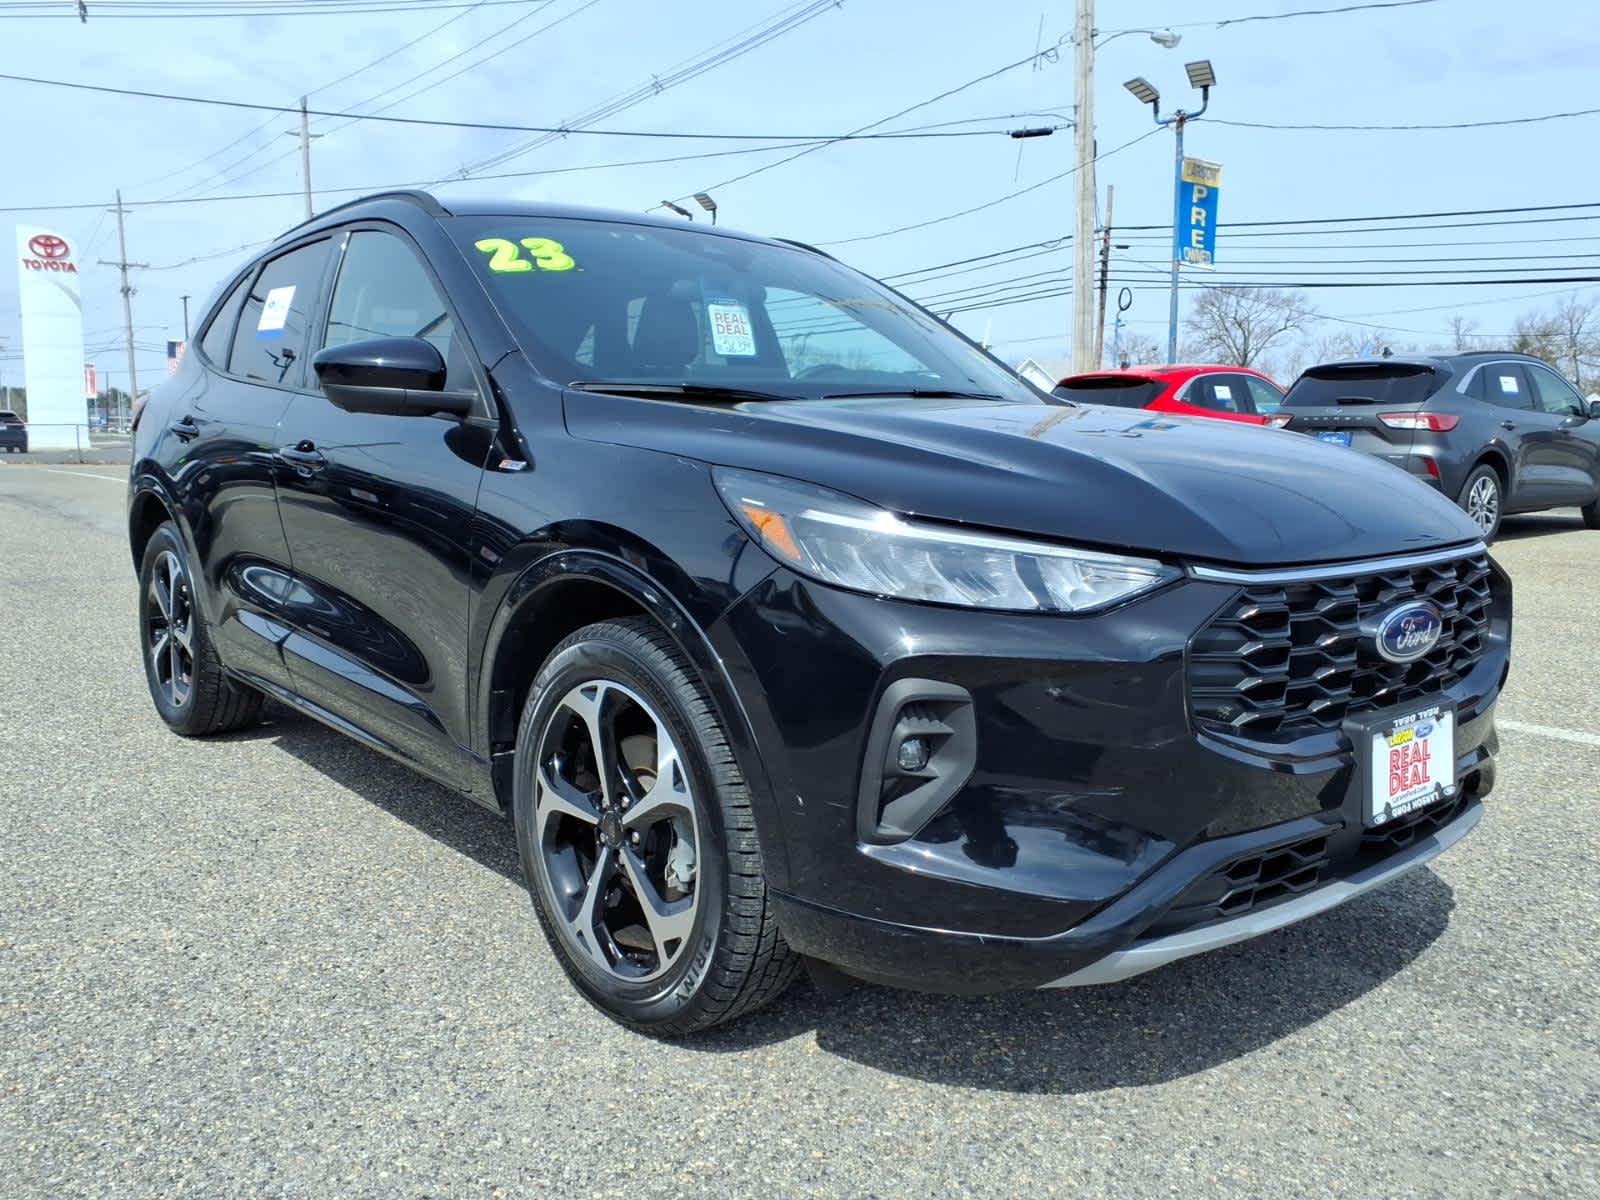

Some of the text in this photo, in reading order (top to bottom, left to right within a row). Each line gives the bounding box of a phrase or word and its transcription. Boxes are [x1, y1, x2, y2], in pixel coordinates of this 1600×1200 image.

[1191, 185, 1208, 248] PRE
[22, 258, 78, 274] TOYOTA
[474, 237, 576, 272] 23
[714, 312, 747, 324] REAL
[716, 324, 749, 336] DEAL
[1396, 616, 1434, 649] Ford
[1390, 739, 1431, 771] REAL
[1389, 762, 1431, 796] DEAL
